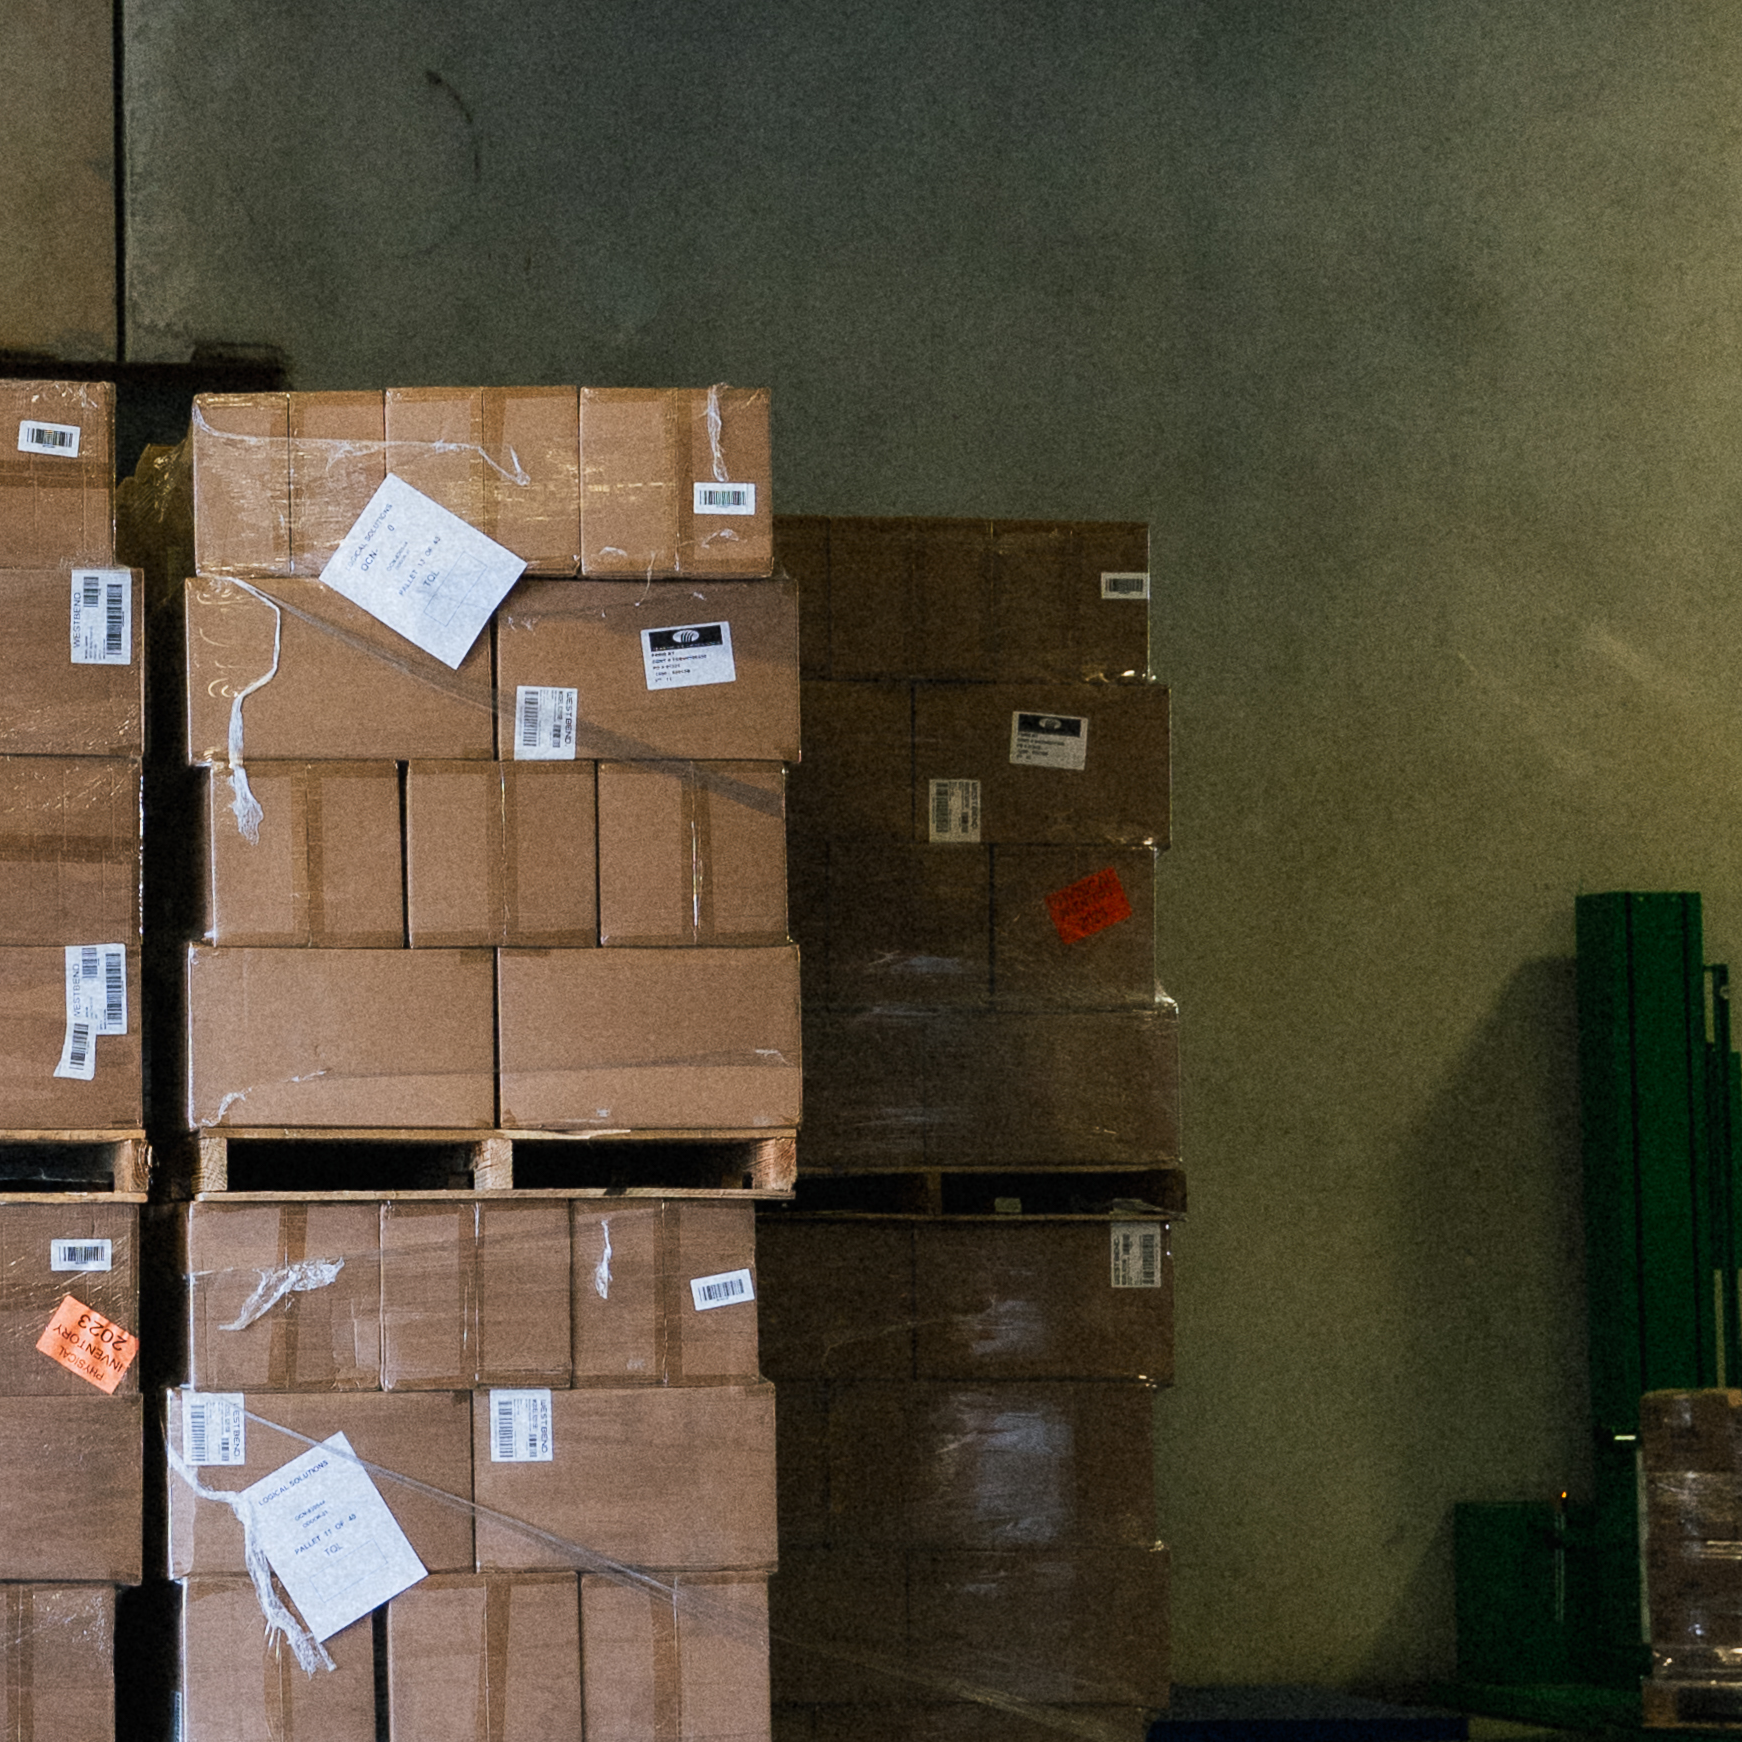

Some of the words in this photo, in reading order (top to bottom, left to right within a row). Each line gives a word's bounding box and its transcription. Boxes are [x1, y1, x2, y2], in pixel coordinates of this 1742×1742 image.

[364, 503, 393, 542] SOLUTIONS
[72, 591, 82, 649] WESTBEND
[52, 1323, 124, 1373] INVENTORY
[77, 1314, 128, 1352] 2023
[58, 1345, 105, 1382] PHYSICAL
[258, 1484, 289, 1507] LOGICAL
[289, 1460, 329, 1488] SOLUTIONS
[294, 1535, 321, 1556] PALLET
[334, 1519, 344, 1530] OF
